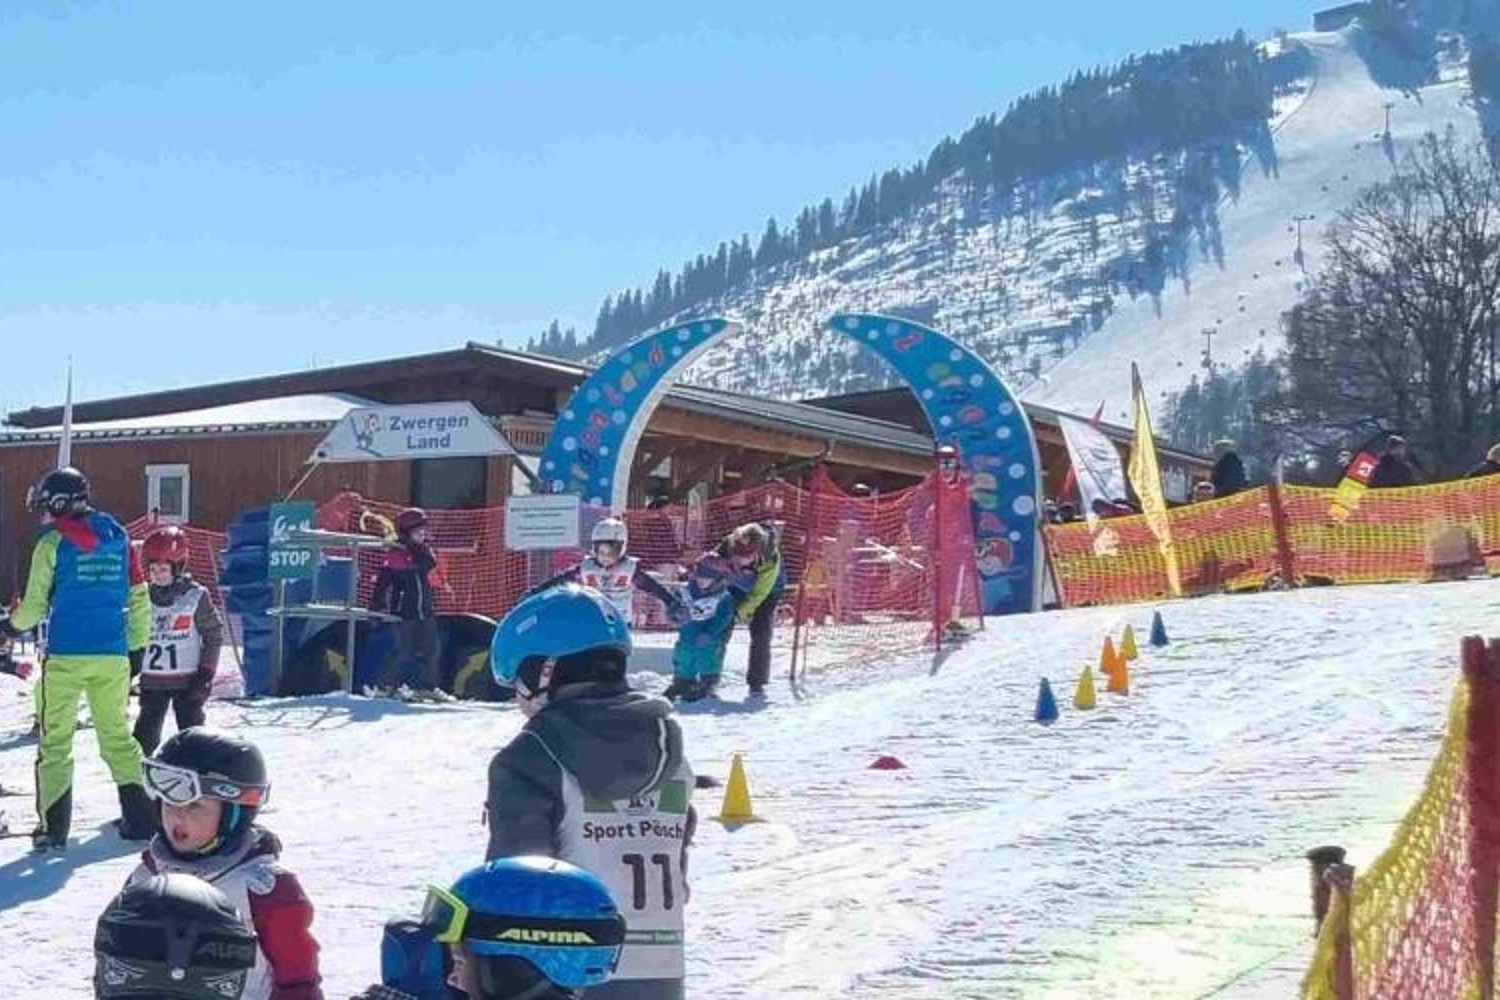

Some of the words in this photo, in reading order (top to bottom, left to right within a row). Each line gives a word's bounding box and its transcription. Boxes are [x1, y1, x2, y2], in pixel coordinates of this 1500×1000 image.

[389, 415, 469, 432] Zwergen
[407, 433, 451, 449] Land
[270, 550, 311, 567] STOP
[149, 643, 178, 671] 21
[583, 821, 635, 842] Sport
[639, 820, 684, 839] Pösch
[622, 853, 674, 911] 11
[495, 927, 597, 944] ALPINA
